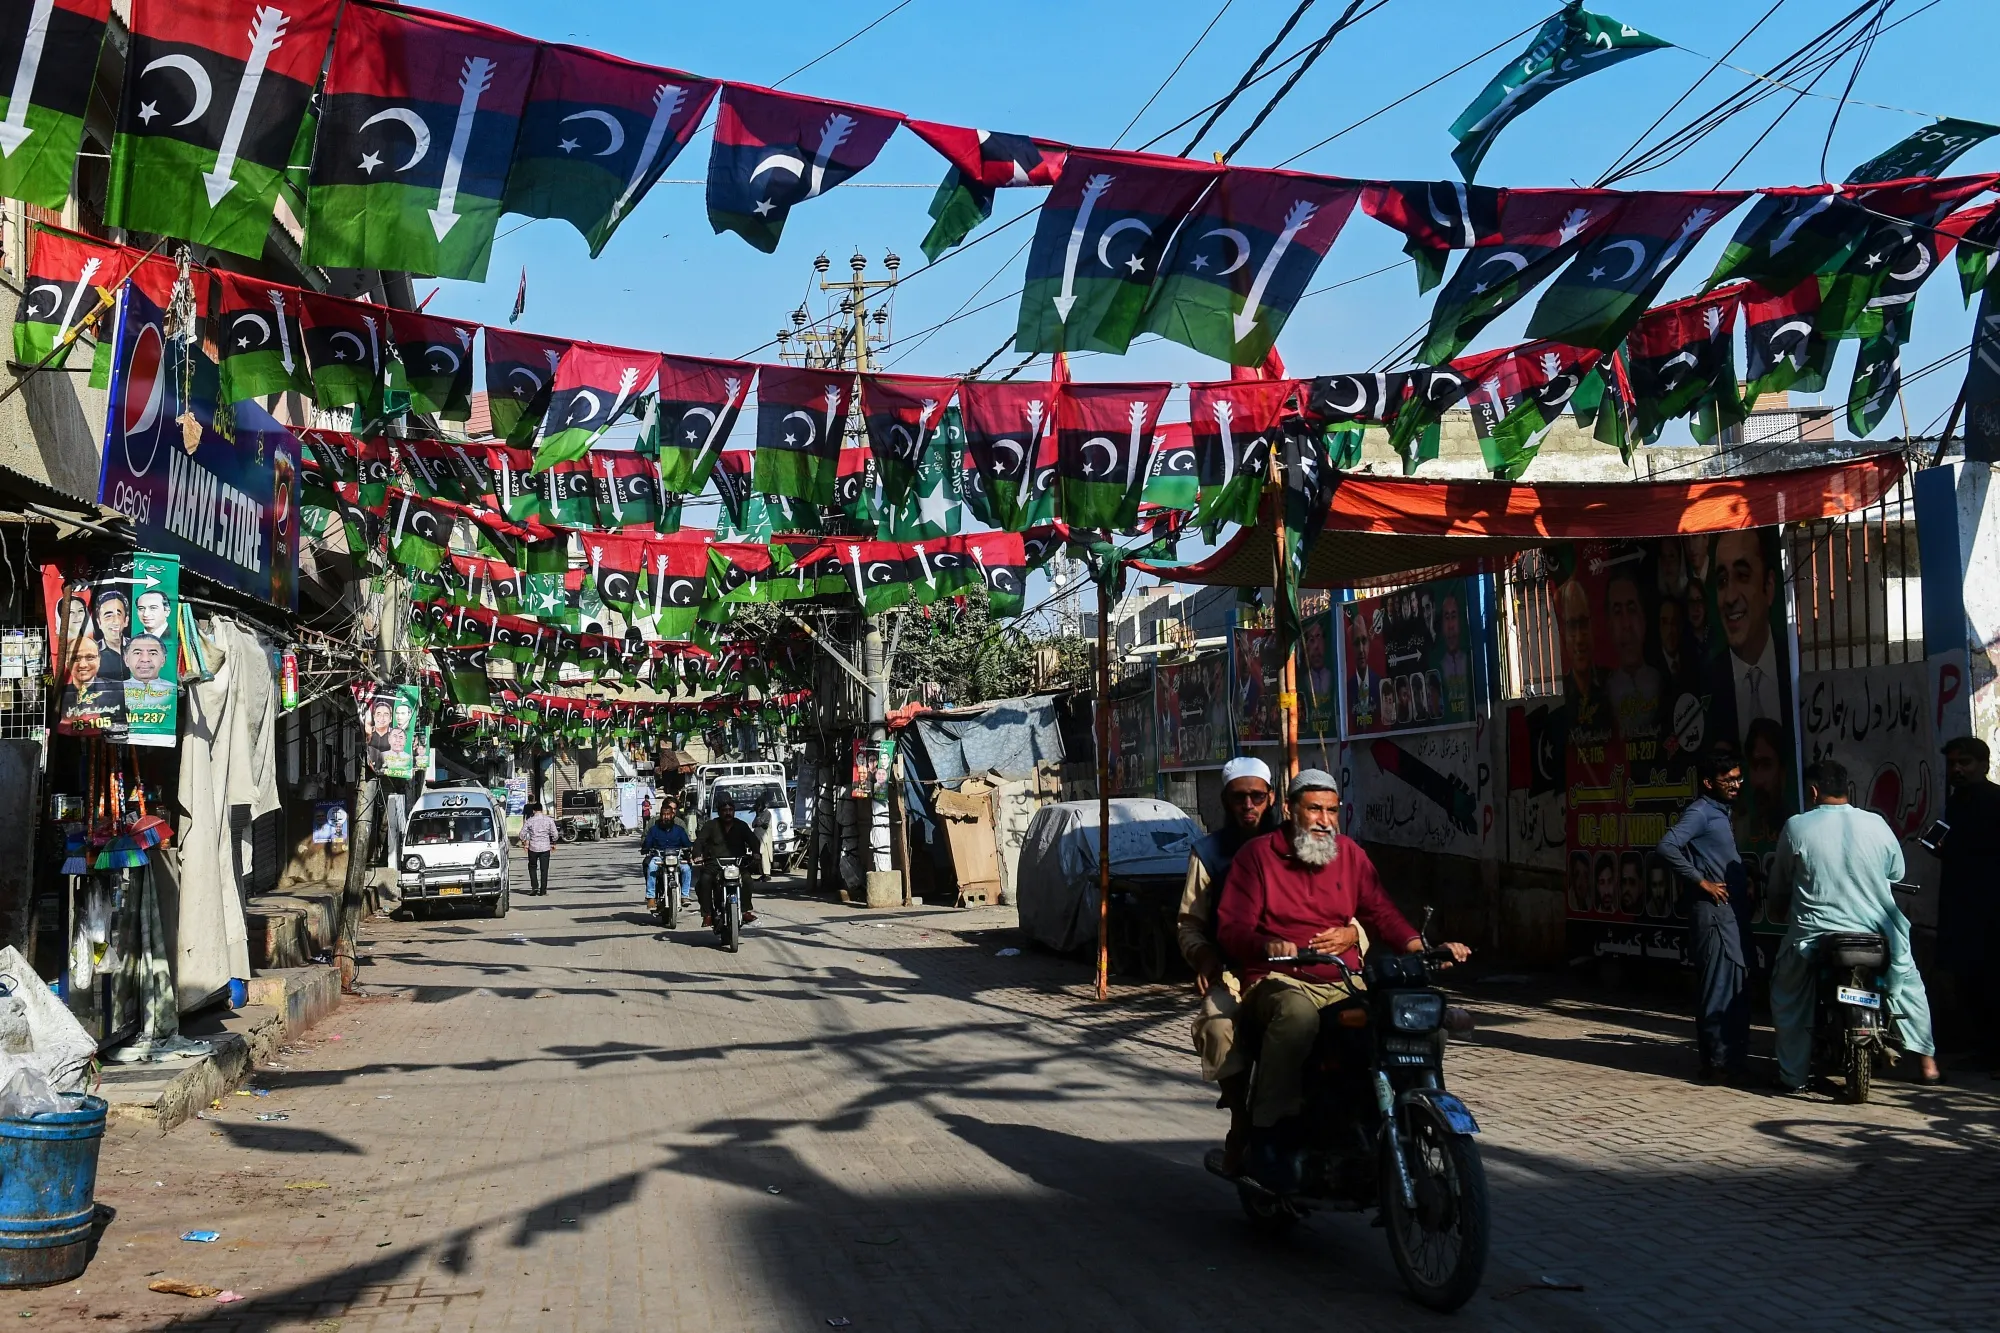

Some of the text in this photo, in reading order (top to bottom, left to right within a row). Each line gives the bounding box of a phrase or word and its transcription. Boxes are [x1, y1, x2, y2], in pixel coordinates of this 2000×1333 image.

[494, 469, 502, 498] PS-105
[510, 470, 520, 497] NA-237
[557, 473, 568, 499] NA-237
[864, 458, 876, 489] PS-105
[950, 450, 962, 494] PS-105
[113, 480, 152, 526] pepsi
[599, 477, 611, 504] PS-105
[615, 477, 628, 504] NA-237
[164, 445, 264, 574] YAHYA STORE
[1936, 663, 1961, 734] P
[73, 717, 113, 731] PS-105
[1626, 742, 1656, 761] NA-237
[1477, 762, 1491, 803] P
[1482, 804, 1494, 845] P
